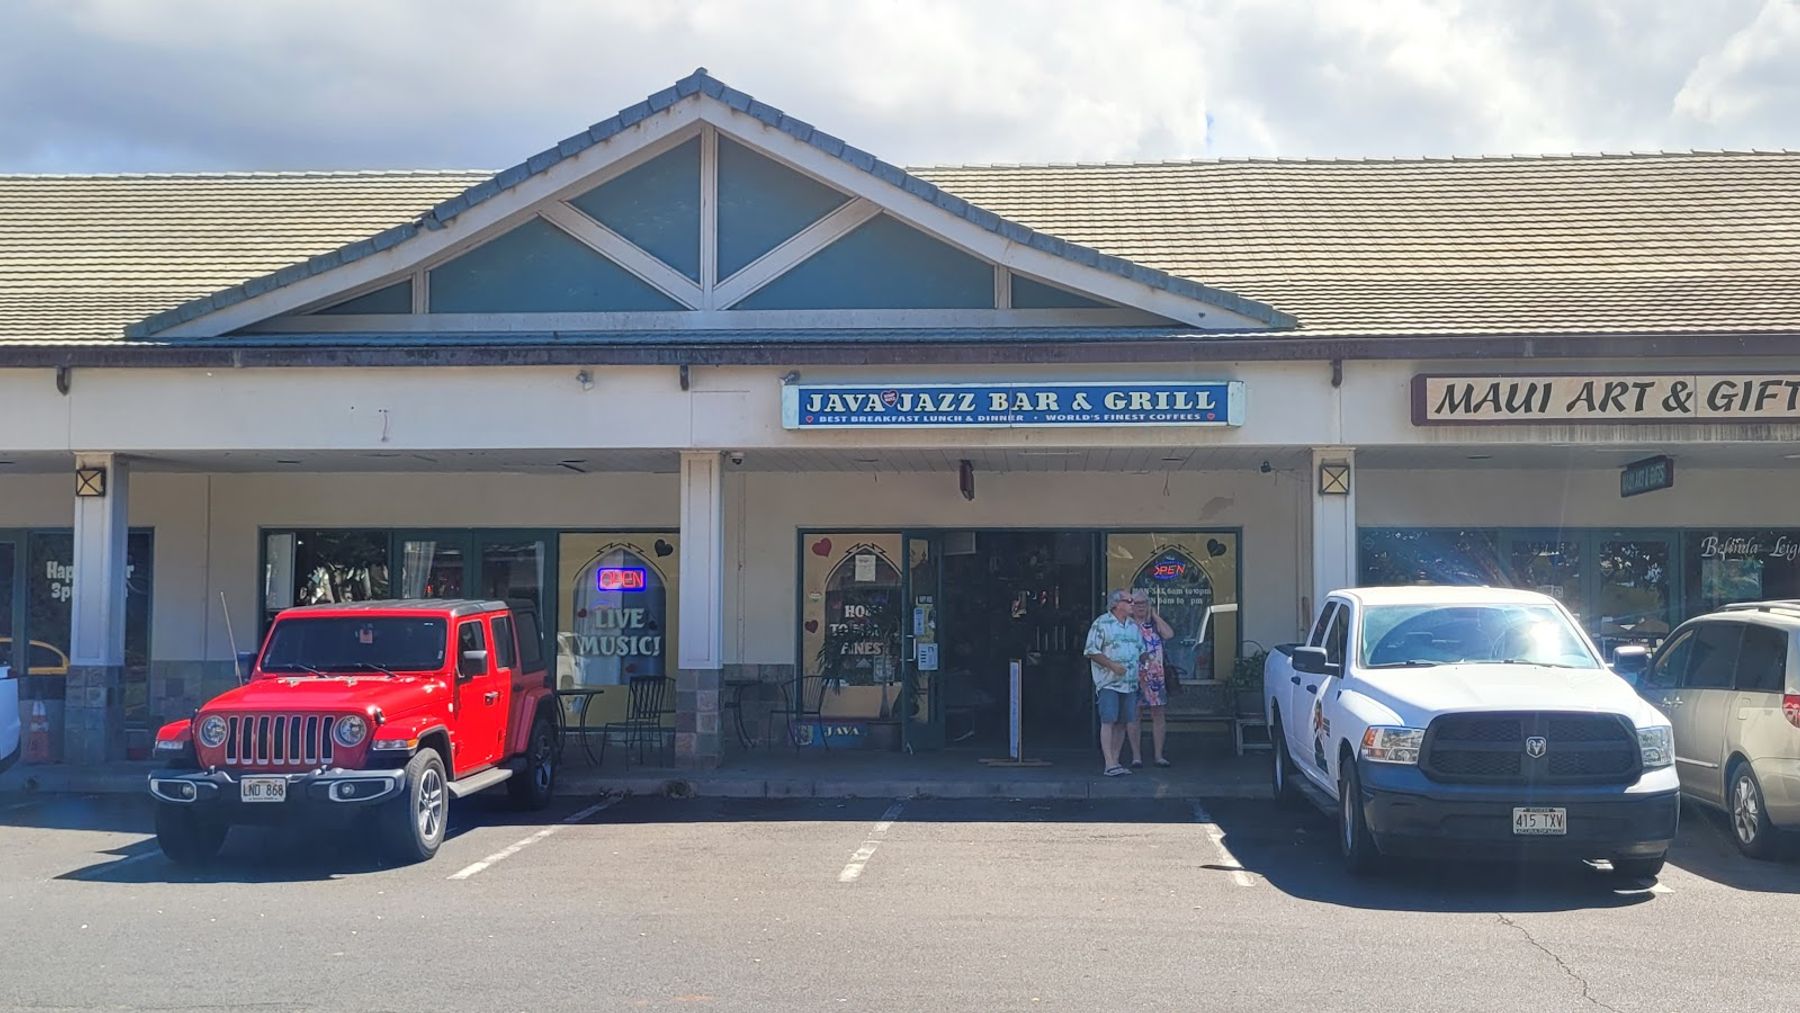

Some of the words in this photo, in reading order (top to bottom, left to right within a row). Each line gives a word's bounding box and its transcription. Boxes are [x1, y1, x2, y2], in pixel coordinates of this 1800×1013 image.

[806, 393, 886, 412] JAVA
[897, 393, 976, 412] JAZZ
[988, 392, 1060, 411] BAR
[1072, 392, 1092, 411] &
[1104, 391, 1216, 410] GRILL
[1434, 382, 1552, 414] MAUI
[1566, 381, 1655, 412] ART
[1661, 381, 1694, 413] &
[1706, 380, 1800, 412] GIFT
[819, 415, 847, 423] BEST
[851, 415, 920, 423] BREAKFAST
[1046, 413, 1100, 421] WORLD'S
[1149, 412, 1201, 420] COFFEES
[1769, 535, 1800, 561] Leig
[601, 571, 643, 587] OPEN
[595, 608, 645, 629] LIVE
[580, 636, 661, 656] MUSIC!
[824, 726, 859, 736] JAVA
[243, 783, 261, 796] LND
[265, 783, 284, 797] 868
[1516, 814, 1536, 828] 415
[1543, 814, 1563, 828] TXV
